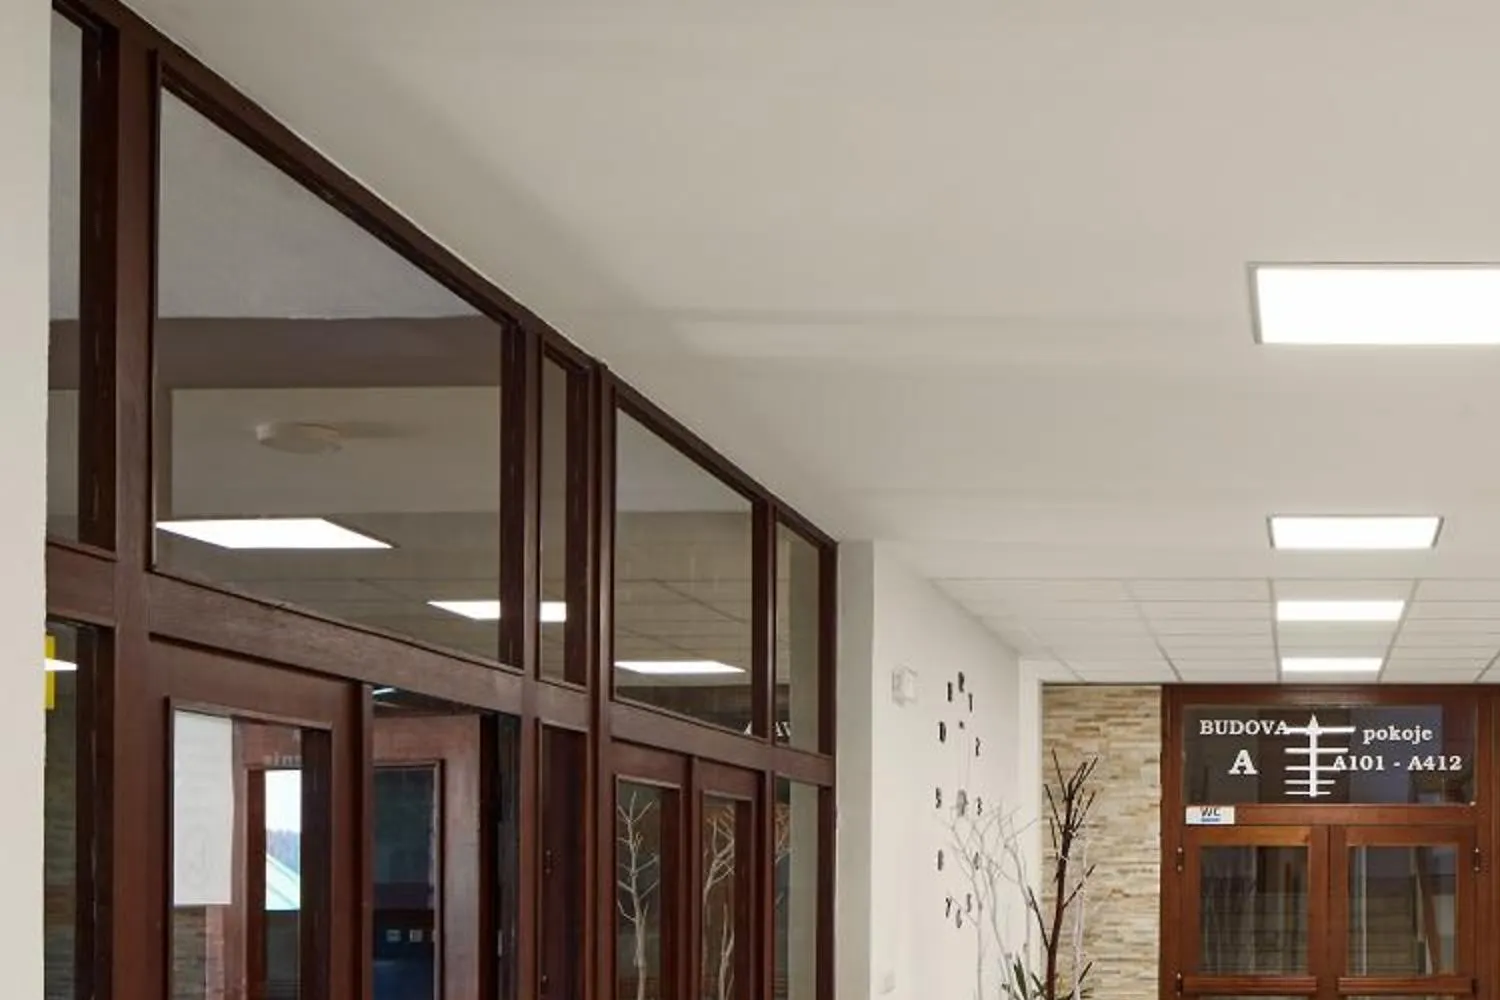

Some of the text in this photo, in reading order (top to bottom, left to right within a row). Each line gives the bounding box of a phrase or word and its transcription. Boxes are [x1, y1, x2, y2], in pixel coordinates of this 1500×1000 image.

[1199, 719, 1290, 735] BUDOVA
[1362, 725, 1433, 745] pokoje
[1228, 749, 1259, 775] A
[1332, 755, 1385, 771] A101
[1407, 755, 1463, 771] A412
